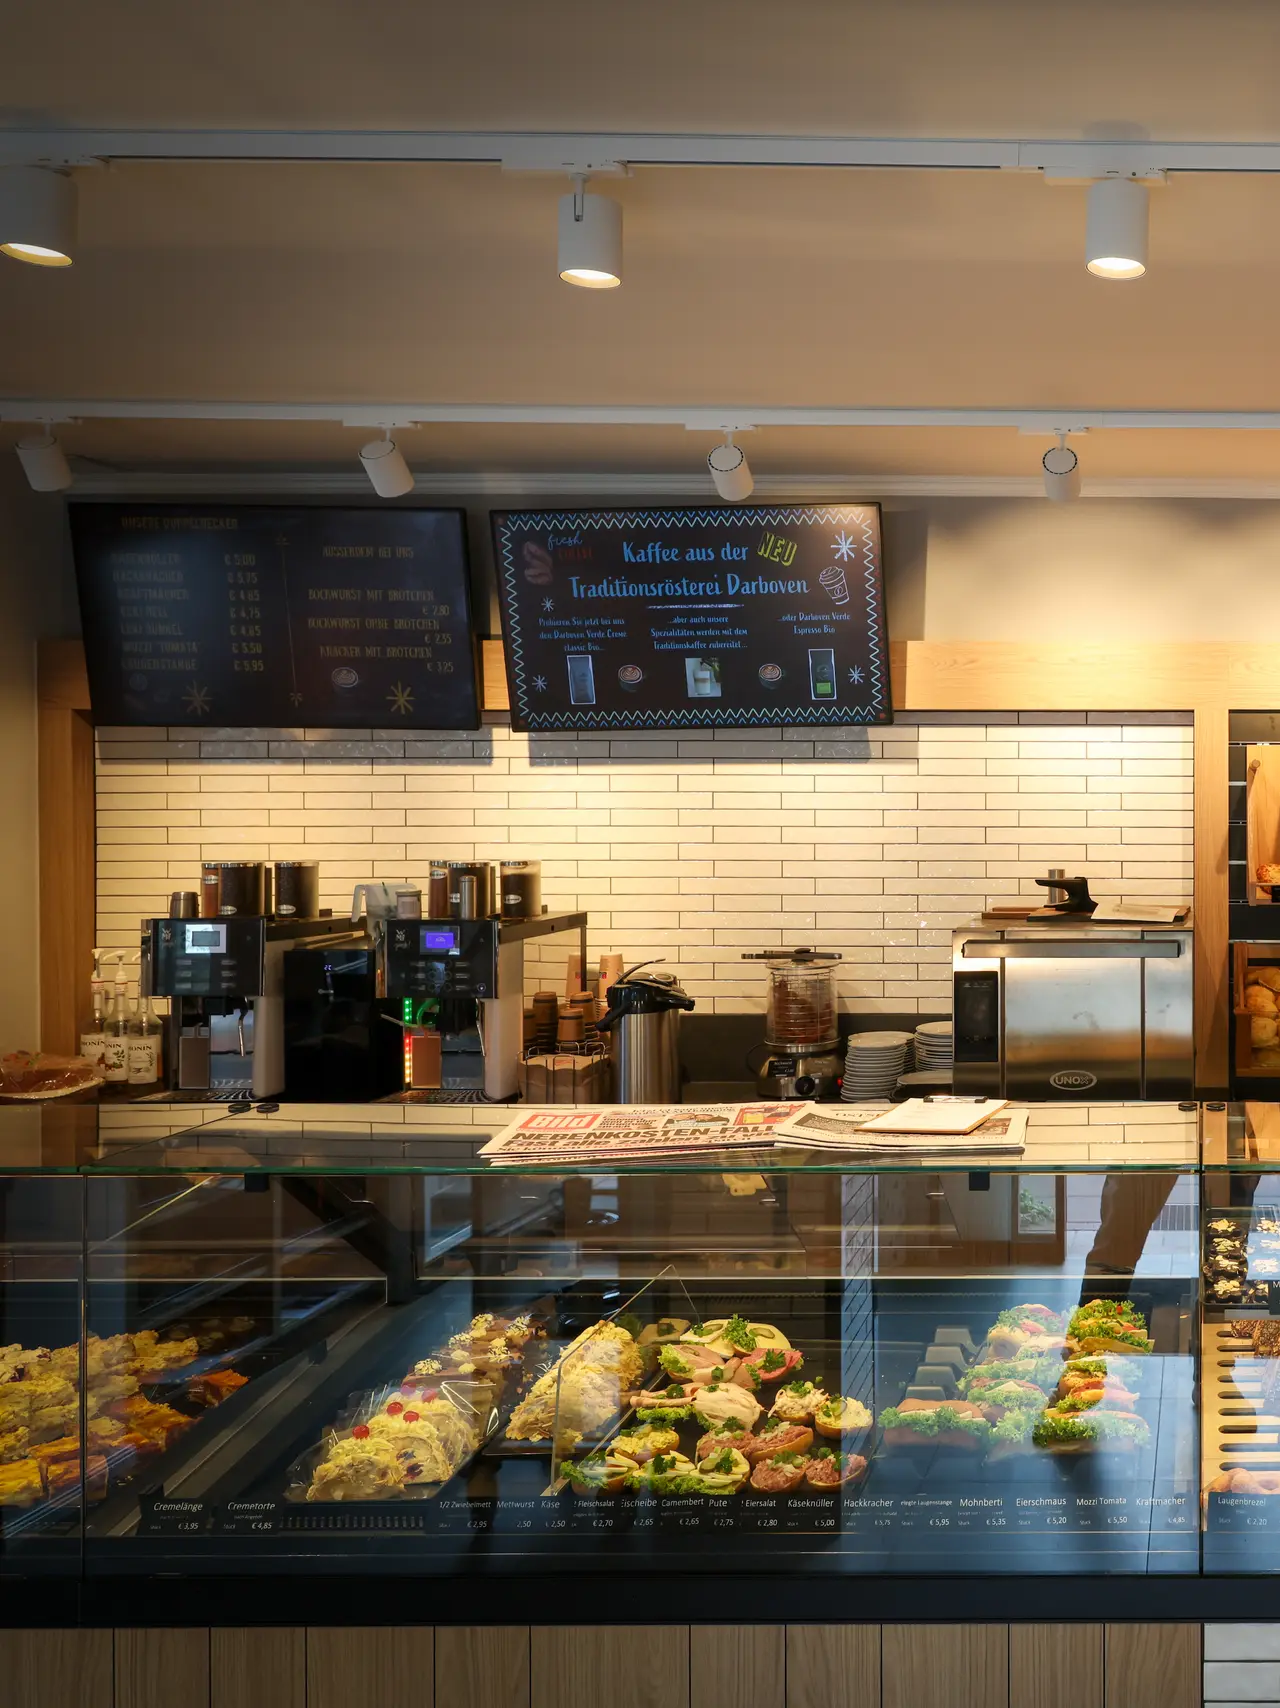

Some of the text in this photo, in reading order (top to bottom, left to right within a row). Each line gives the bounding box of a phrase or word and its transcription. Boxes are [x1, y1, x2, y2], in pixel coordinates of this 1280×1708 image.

[548, 530, 583, 551] fresh
[622, 540, 749, 564] Kaffee aus der
[756, 531, 798, 567] NEU
[568, 573, 812, 599] Traditionsrösterei Darboven
[689, 616, 705, 624] auch
[798, 612, 830, 622] Darboven
[831, 611, 851, 621] Verde
[586, 630, 605, 638] Verde
[650, 628, 695, 638] Spezialitäten
[696, 627, 720, 636] werden
[734, 628, 748, 636] dem
[793, 625, 836, 635] Espresso Bio
[653, 641, 707, 650] Traditionskaffee
[1054, 1074, 1091, 1086] UNOX
[527, 1113, 596, 1129] Bild
[503, 1136, 701, 1147] Fast alle zahlen
[541, 1500, 560, 1508] Käse
[661, 1499, 704, 1507] Camembert
[708, 1499, 728, 1507] Pute
[788, 1499, 834, 1507] Käseknüller
[843, 1499, 894, 1507] Hackkracher
[960, 1498, 1003, 1507] Mohnberti
[1016, 1498, 1067, 1506] Eierschmaus
[1099, 1497, 1127, 1505] Tomata
[1136, 1497, 1186, 1506] Kraftmacher
[1218, 1497, 1266, 1507] Laugenbrezel
[153, 1502, 203, 1512] Cremelänge
[227, 1502, 276, 1510] Cremetorte
[517, 1520, 532, 1528] 2,50
[551, 1520, 566, 1528] 2,50
[598, 1519, 613, 1527] 2,70
[639, 1518, 654, 1526] 2,65
[685, 1518, 699, 1526] 2,65
[719, 1519, 734, 1527] 2,75
[763, 1519, 778, 1527] 2,80
[820, 1519, 835, 1527] 5,00
[879, 1519, 891, 1527] 5,75
[935, 1518, 950, 1527] 5,95
[991, 1518, 1006, 1526] 5,35
[1113, 1516, 1128, 1524] 5,50
[1252, 1517, 1267, 1526] 2,20
[184, 1522, 199, 1530] 3,95
[257, 1522, 272, 1530] 4,85
